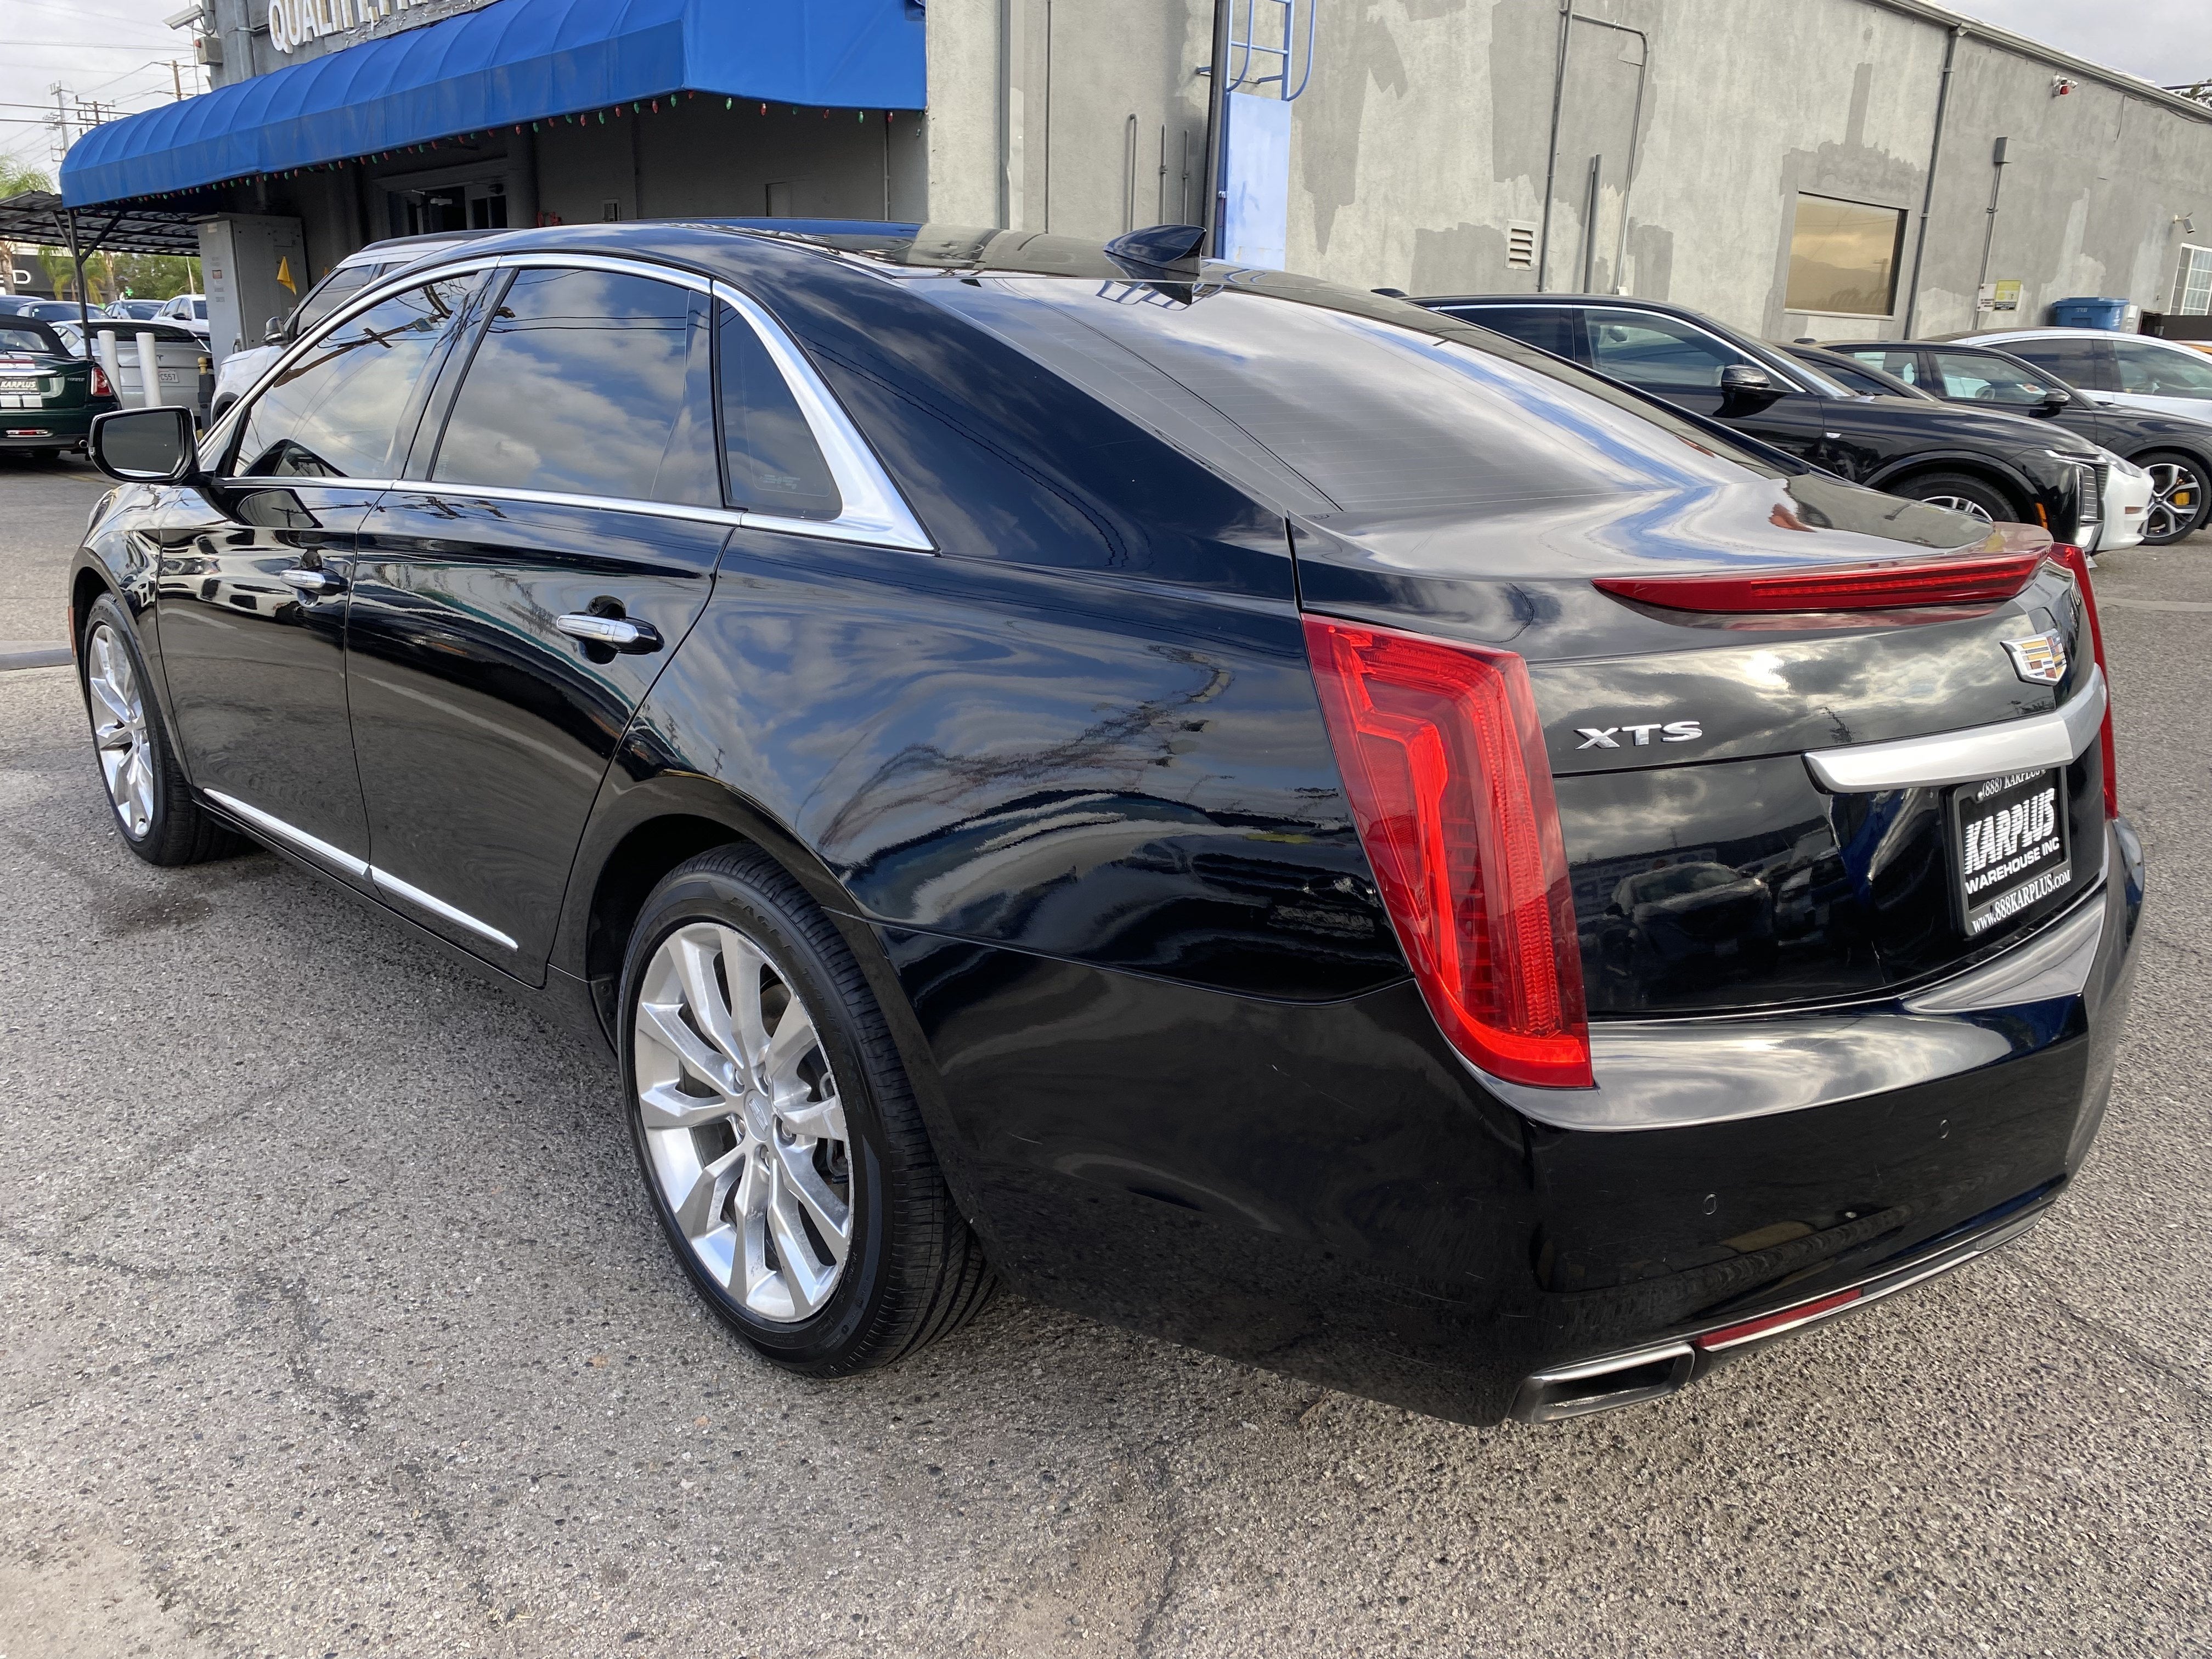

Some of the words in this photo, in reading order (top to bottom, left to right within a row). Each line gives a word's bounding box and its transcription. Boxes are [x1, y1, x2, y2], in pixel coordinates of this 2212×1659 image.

[1574, 721, 1703, 751] XTS
[1982, 777, 2002, 797] (888)
[1964, 788, 2055, 874] KARPLUS
[1966, 847, 2041, 894] WAREHOUSE
[2042, 837, 2060, 856] INC
